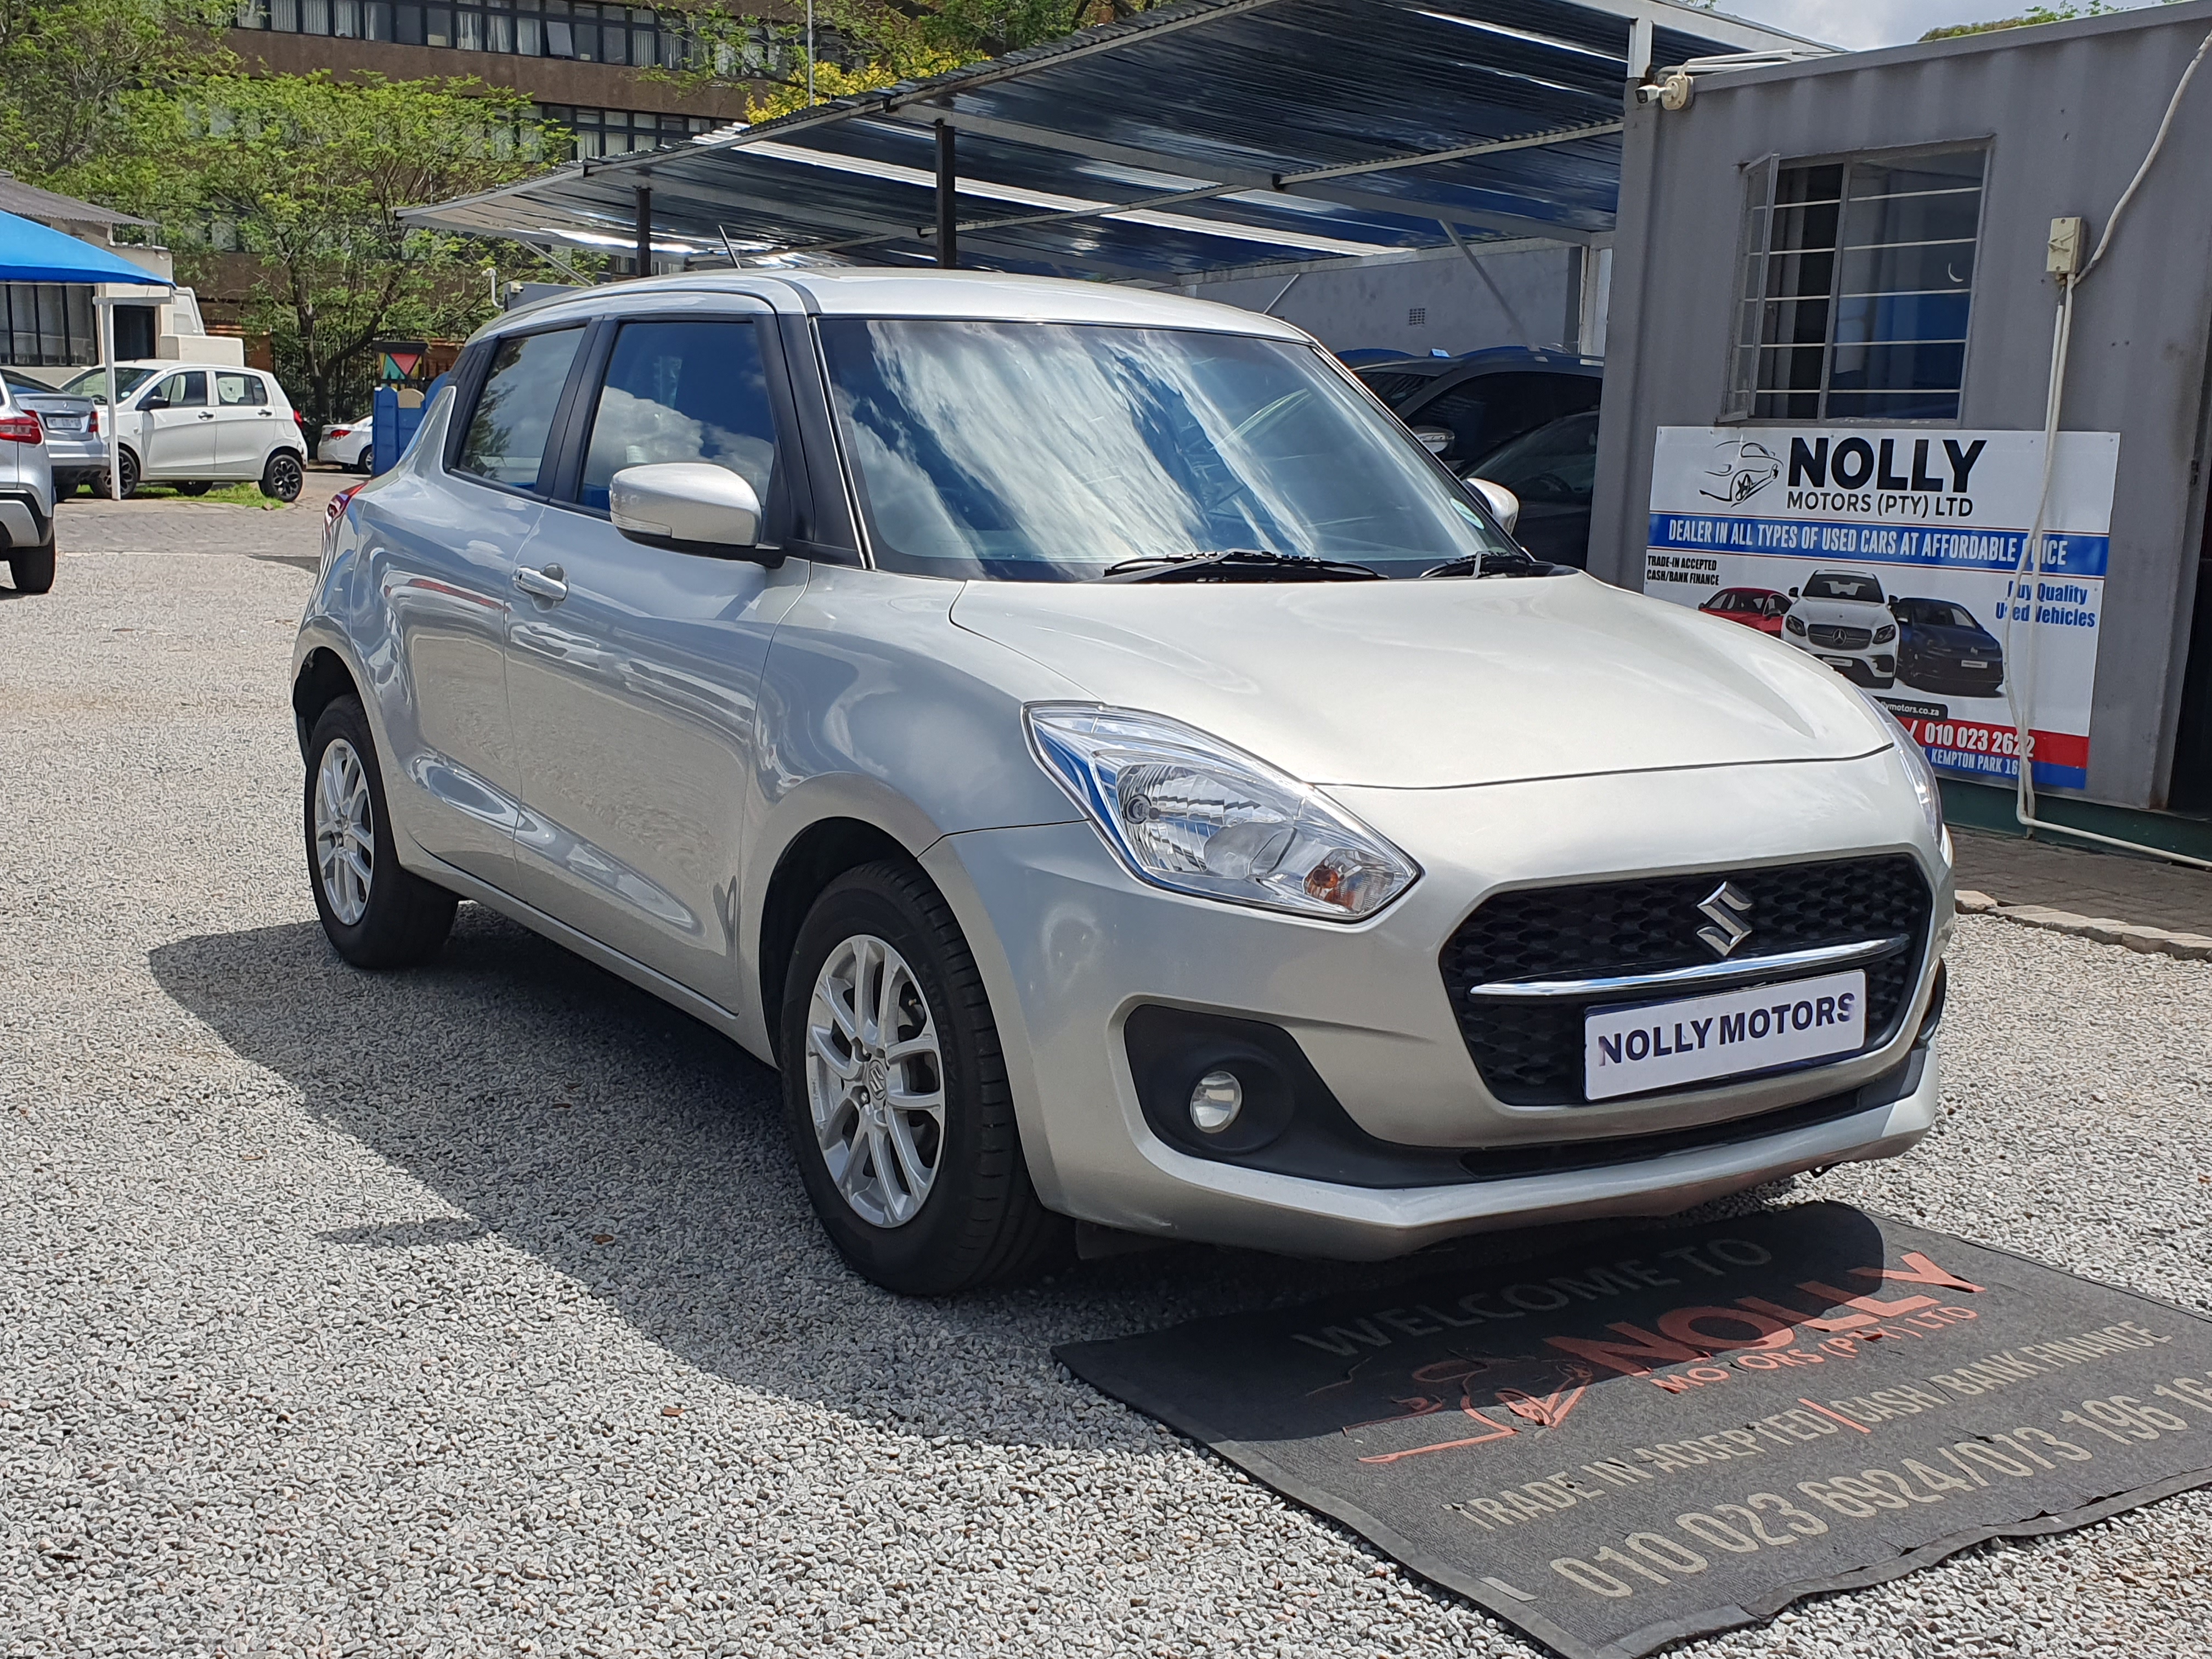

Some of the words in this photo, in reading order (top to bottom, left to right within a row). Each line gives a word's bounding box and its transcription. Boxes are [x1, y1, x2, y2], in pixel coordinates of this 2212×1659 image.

[1788, 437, 1987, 493] NOLLY
[1787, 491, 1871, 512] MOTORS
[1877, 493, 1928, 518] (PTY)
[1936, 496, 1973, 517] LTD
[1647, 555, 1680, 568] TRADE-IN
[1680, 558, 1717, 571] ACCEPTED
[1669, 519, 1711, 543] DEALER
[1716, 522, 1728, 544] IN
[1731, 523, 1753, 546] ALL
[1758, 524, 1797, 549] TYPES
[1802, 526, 1819, 549] OF
[1822, 527, 1857, 552] USED
[1861, 529, 1897, 555] CARS
[1899, 532, 1919, 556] AT
[1921, 533, 2017, 562] AFFORDABLE
[2022, 539, 2068, 565] ICE
[1646, 569, 1689, 583] CASH/BANK
[1690, 573, 1720, 585] FINANCE
[2037, 583, 2087, 605] Quality
[1925, 722, 1954, 746] 010
[1956, 727, 1988, 751] 023
[1931, 748, 1974, 769] KEMPTON
[1977, 754, 2002, 772] PARK
[1598, 1017, 1713, 1066] NOLLY
[1719, 992, 1855, 1045] MOTORS
[1291, 1259, 1680, 1356] WELCOME
[1664, 1238, 1772, 1276] TO
[1542, 1250, 1986, 1377] NOLLY
[1649, 1348, 1825, 1394] MOORS
[1906, 1307, 1978, 1329] LTD
[1440, 1471, 1606, 1531] TRADE
[1580, 1457, 1654, 1486] IN
[1633, 1408, 1839, 1474] ACCEPTED
[2018, 1321, 2174, 1368] FINANCE
[1550, 1532, 1707, 1597] 010
[1675, 1493, 1829, 1553] 023
[2059, 1395, 2188, 1445] 196
